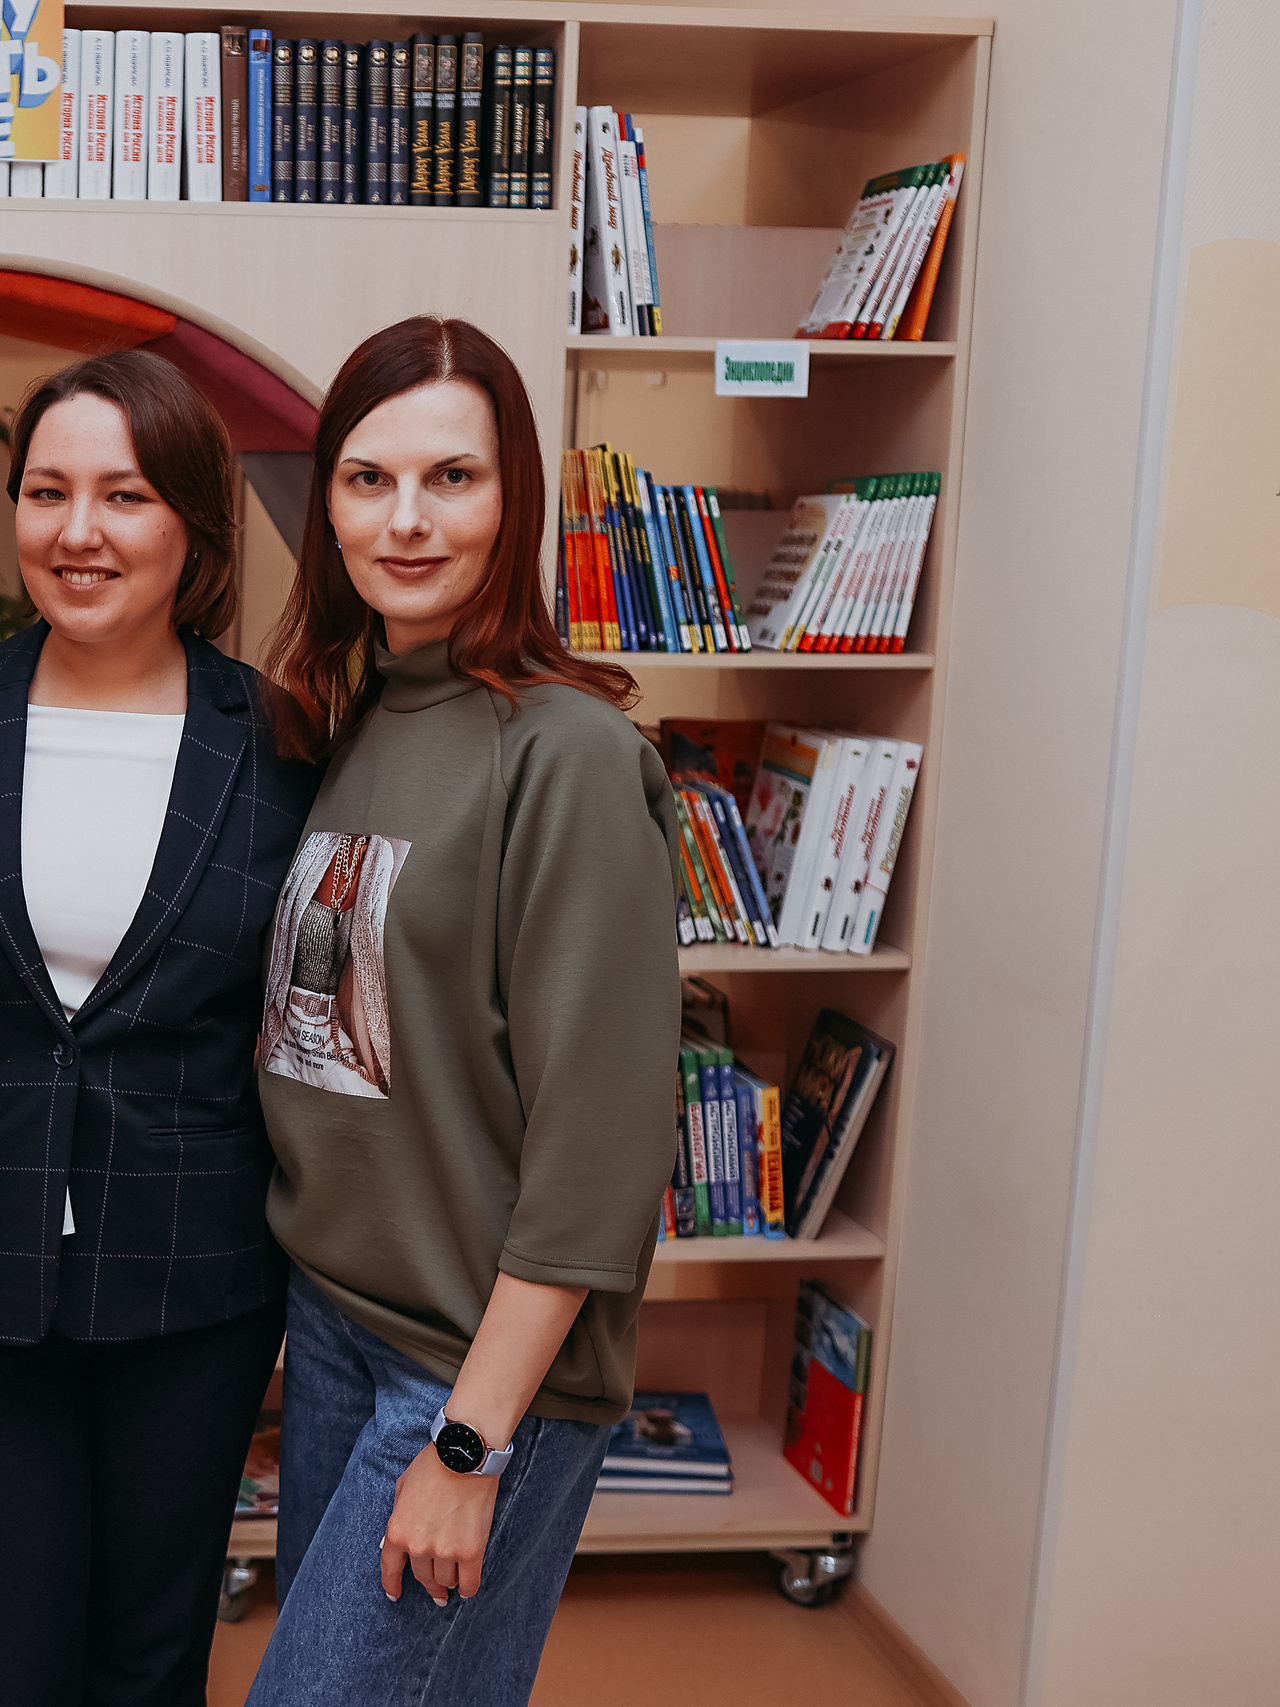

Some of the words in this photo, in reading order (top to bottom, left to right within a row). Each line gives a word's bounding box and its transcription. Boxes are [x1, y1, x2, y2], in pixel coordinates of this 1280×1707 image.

[412, 120, 432, 153] Узала
[434, 121, 453, 154] Узала
[459, 120, 480, 153] Узала
[409, 157, 432, 193] Дерсу
[434, 158, 453, 194] Дерсу
[456, 157, 480, 194] Дерсу
[725, 356, 795, 386] Энциклопедии
[301, 1030, 325, 1044] SEASON
